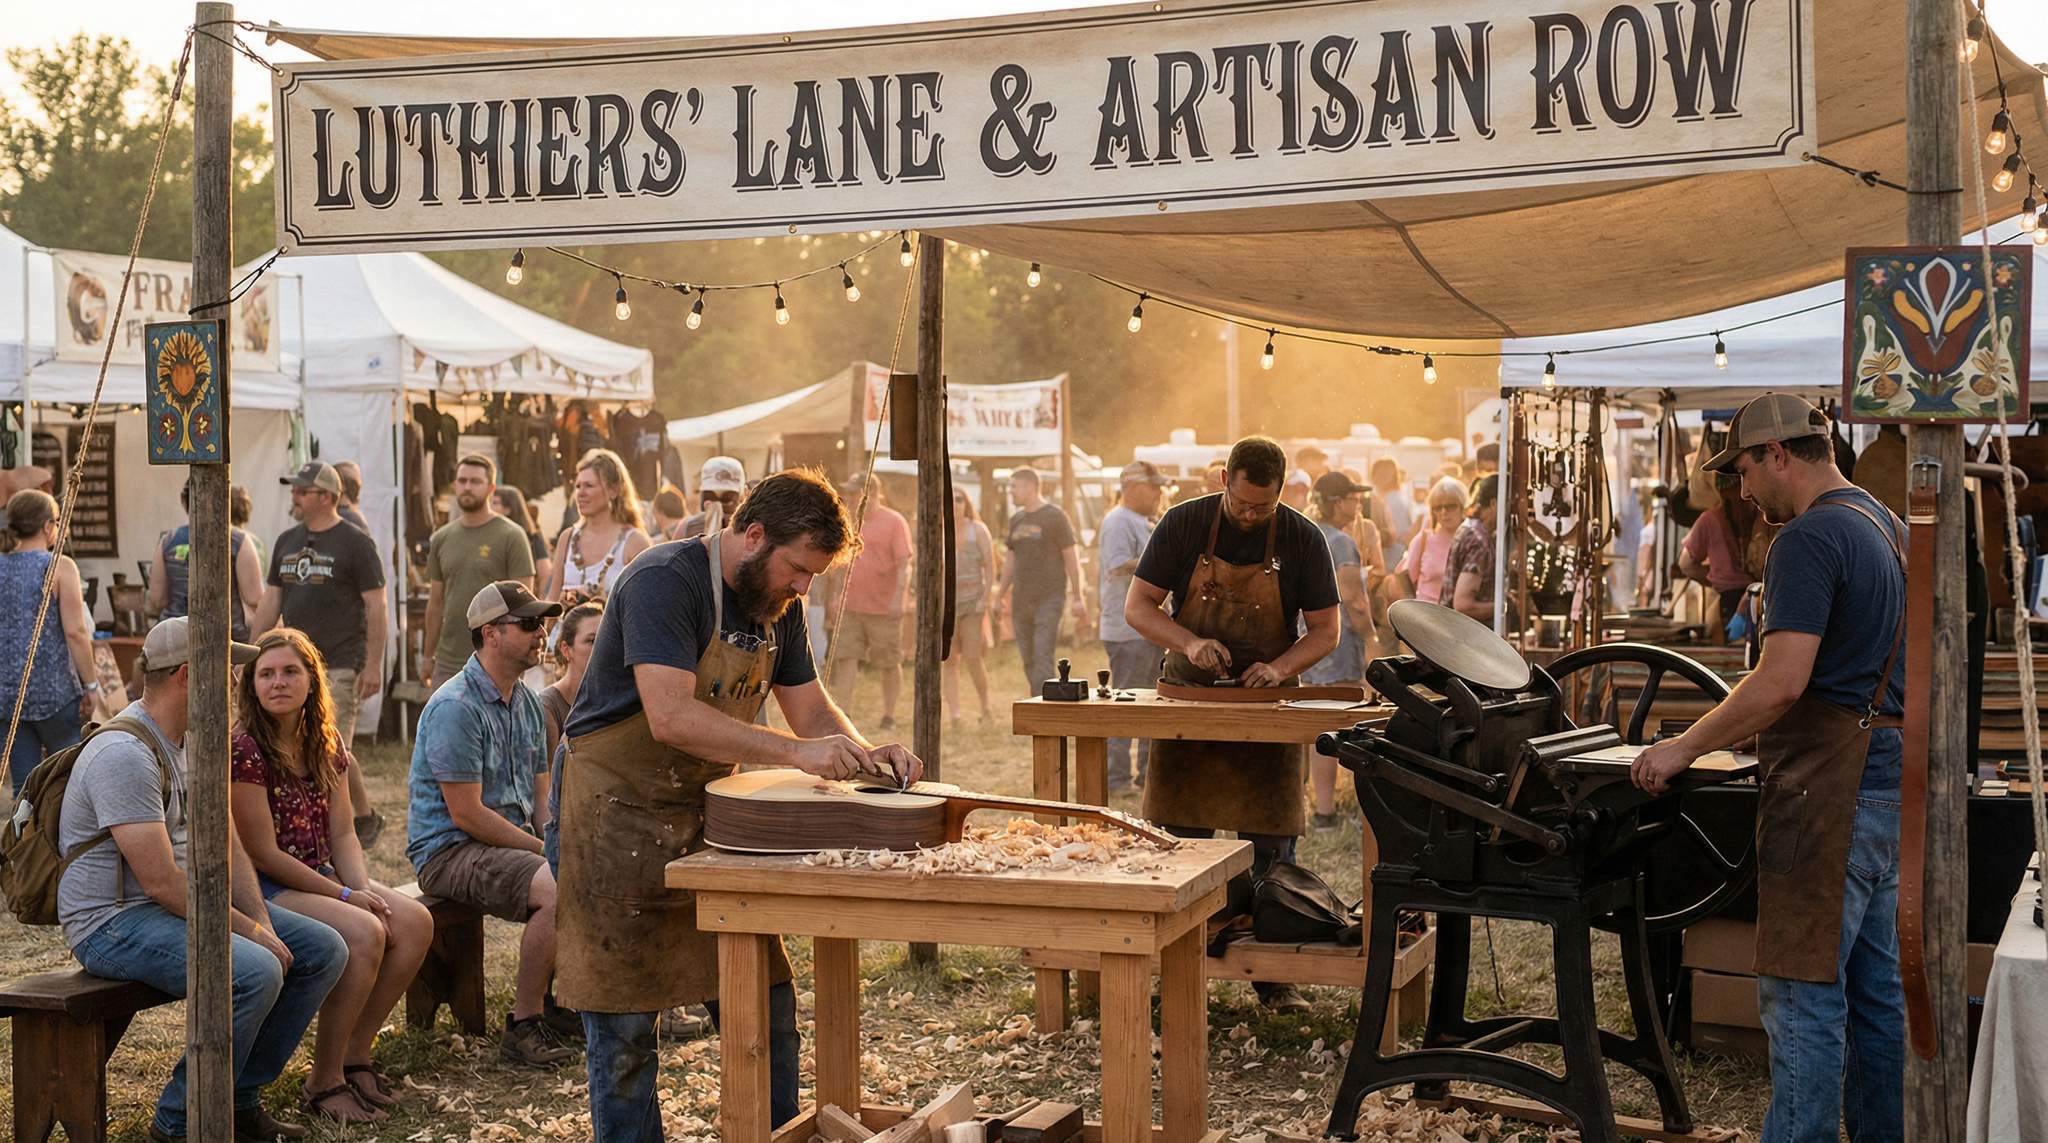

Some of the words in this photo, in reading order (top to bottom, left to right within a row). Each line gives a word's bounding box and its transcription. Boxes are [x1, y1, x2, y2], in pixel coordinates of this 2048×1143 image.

[312, 87, 704, 211] LUTHIERS'
[731, 71, 946, 193] LANE
[979, 63, 1057, 178] &
[1090, 21, 1497, 170] ARTISAN
[1528, 0, 1754, 135] ROW
